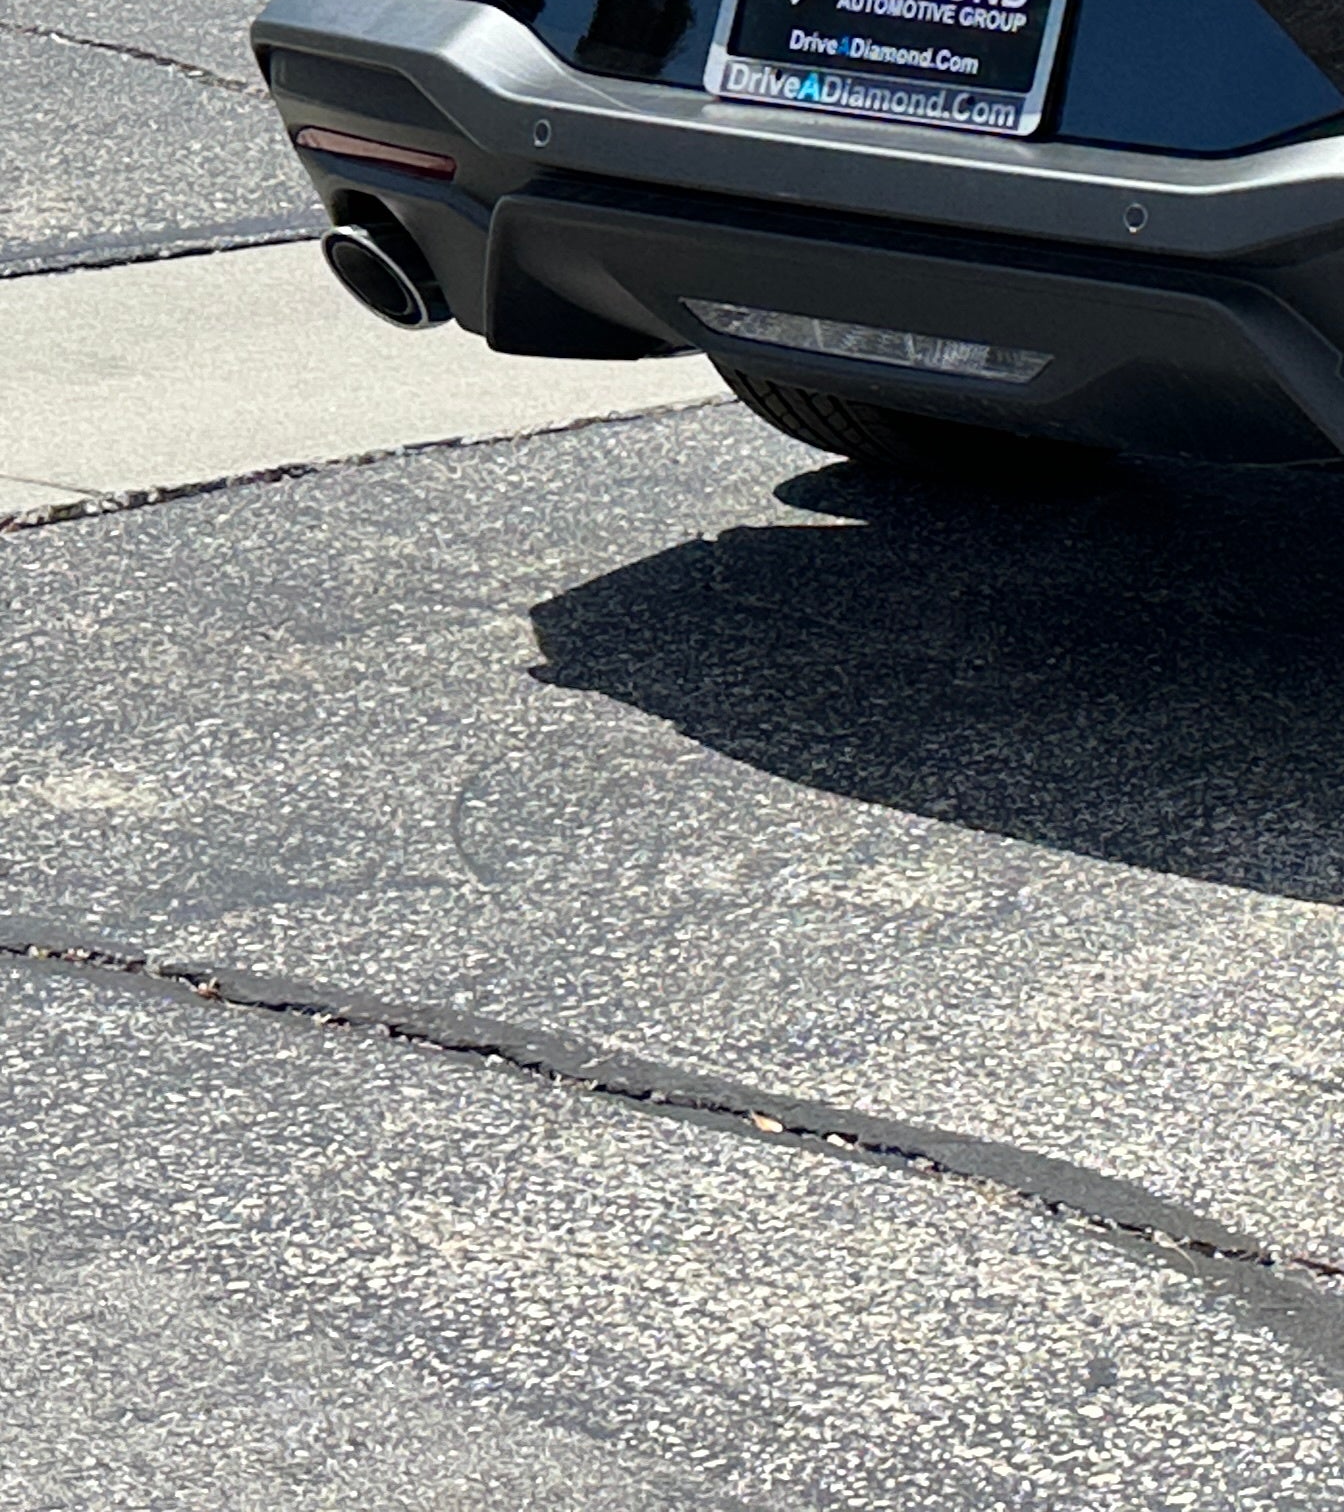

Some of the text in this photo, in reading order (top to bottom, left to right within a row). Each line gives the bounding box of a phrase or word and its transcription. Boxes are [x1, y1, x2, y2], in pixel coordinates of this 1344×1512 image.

[958, 8, 1027, 33] GROUP
[789, 29, 980, 75] DriveADiamond.Com
[727, 65, 1016, 127] DriveADiamond.Com
